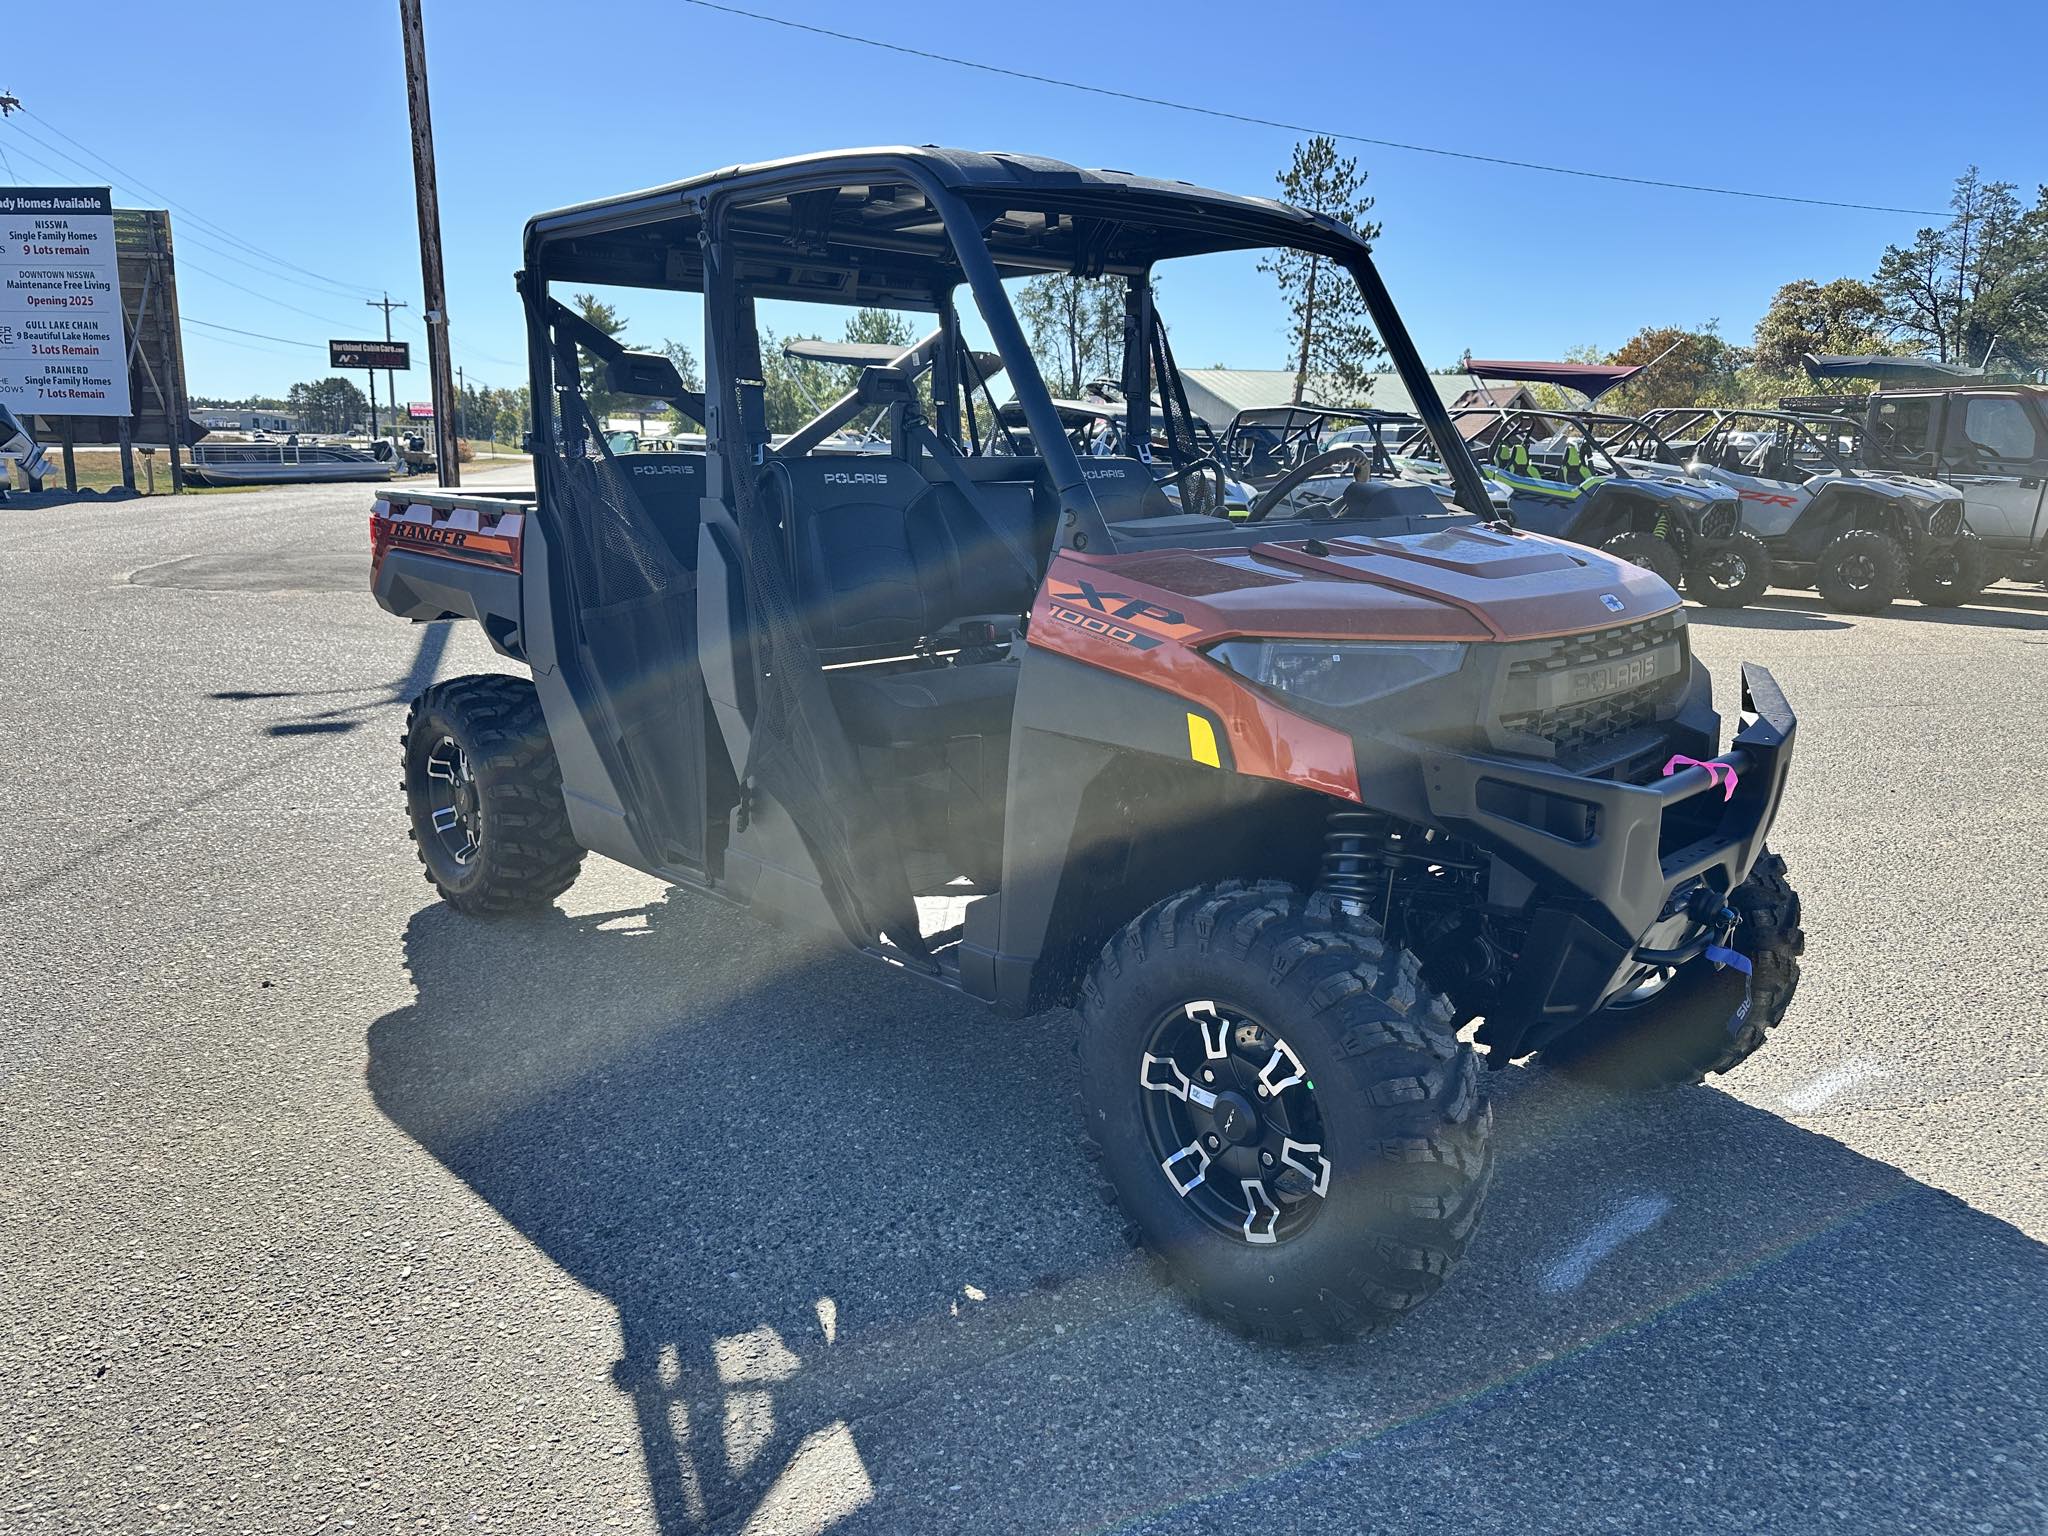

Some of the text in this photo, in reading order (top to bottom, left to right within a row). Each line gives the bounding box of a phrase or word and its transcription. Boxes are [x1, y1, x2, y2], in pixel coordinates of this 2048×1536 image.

[17, 198, 51, 208] Homes
[53, 198, 101, 208] Available
[35, 220, 68, 229] NISSWA
[9, 231, 98, 242] Single Family Homes
[23, 245, 90, 255] 9 Lots remain
[19, 270, 96, 279] DOWNTOWN NISSWA
[7, 280, 111, 291] Maintenance Free Living
[27, 295, 94, 307] Opening 2025
[25, 321, 99, 330] GULL LAKE CHAIN
[16, 332, 110, 341] 9 Beautiful Lake Homes
[31, 345, 100, 355] 3 Lots Remain
[332, 343, 362, 352] Northland
[45, 366, 89, 374] BRAINERD
[25, 376, 112, 387] Single Family Homes
[38, 389, 105, 399] 7 Lots Remain
[633, 465, 695, 475] POLARIS
[823, 473, 888, 484] POLARIS
[395, 523, 467, 546] RANGER
[1051, 579, 1186, 625] XP
[1048, 605, 1137, 643] 1000
[1575, 655, 1654, 696] POLARIS
